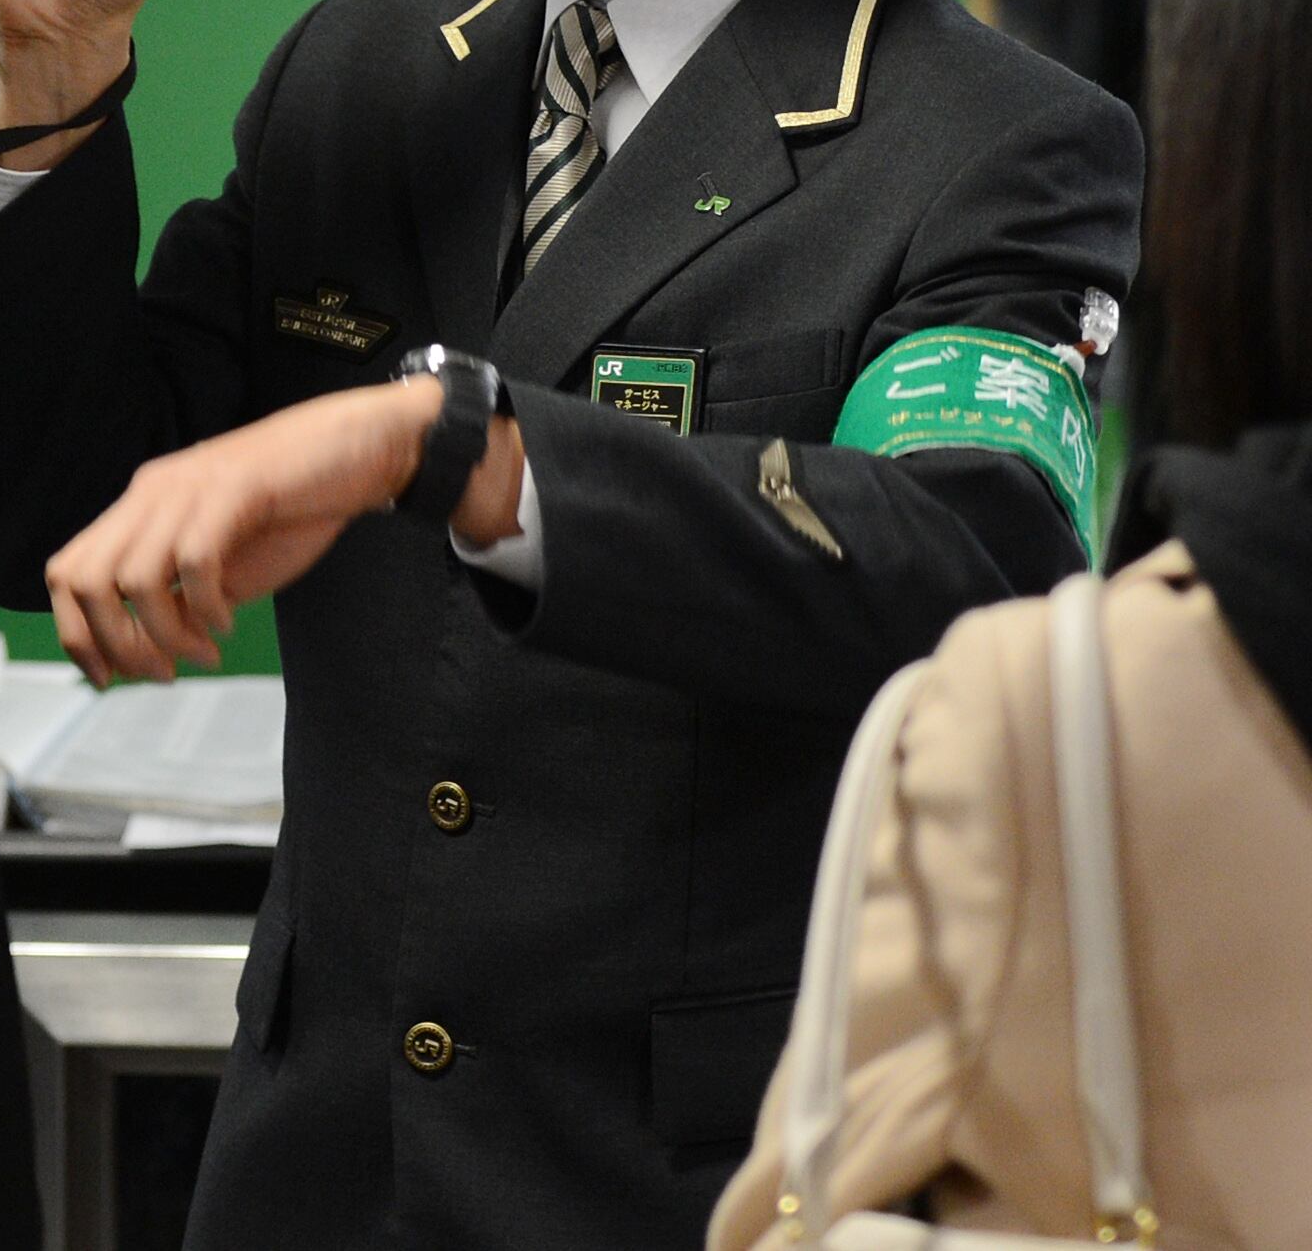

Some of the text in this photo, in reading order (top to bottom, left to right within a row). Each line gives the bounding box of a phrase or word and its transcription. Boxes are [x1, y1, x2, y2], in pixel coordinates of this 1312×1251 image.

[694, 195, 732, 216] JR
[598, 361, 624, 378] JR
[624, 388, 661, 400] サービス
[614, 399, 670, 412] マネージャー
